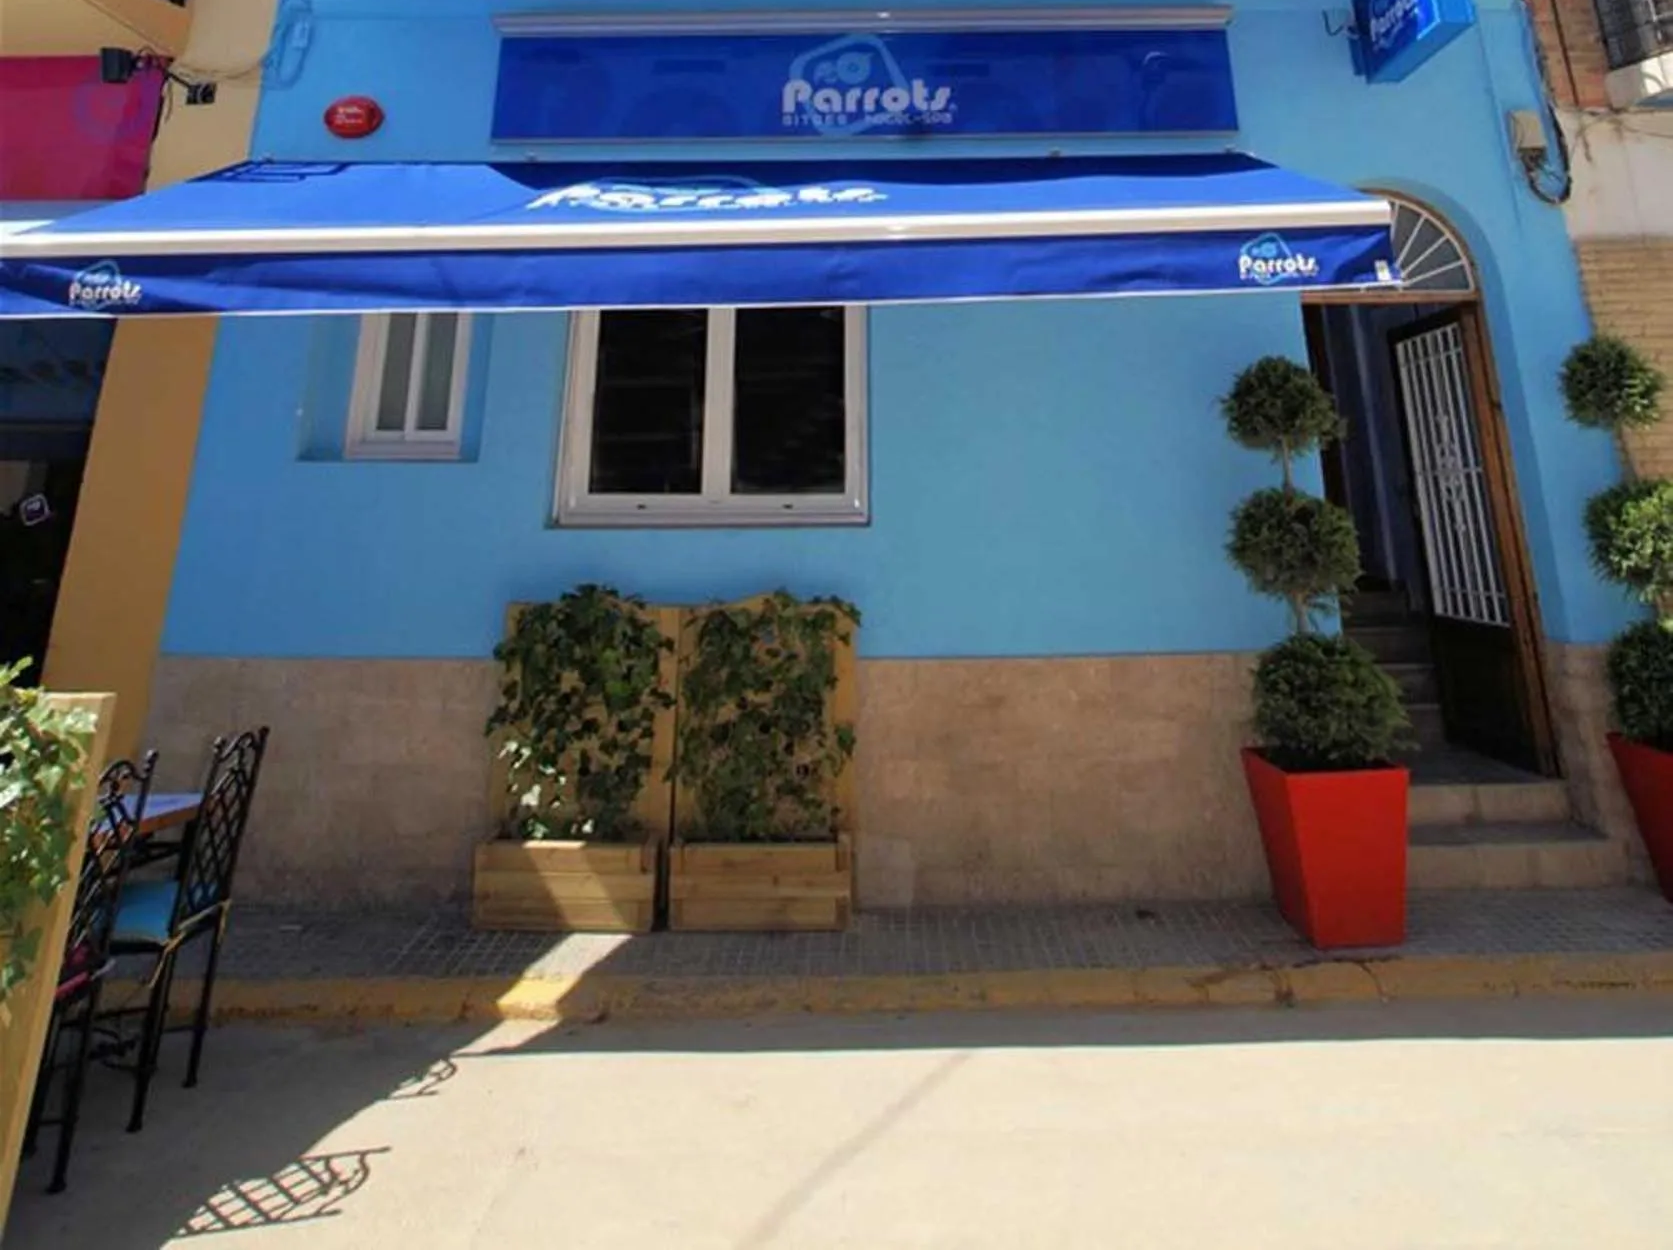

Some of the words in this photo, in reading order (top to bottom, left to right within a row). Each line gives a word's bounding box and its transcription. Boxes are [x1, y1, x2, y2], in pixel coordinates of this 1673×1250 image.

[782, 78, 951, 113] Parrots
[1239, 253, 1316, 273] Parrots
[68, 280, 142, 300] Parrots
